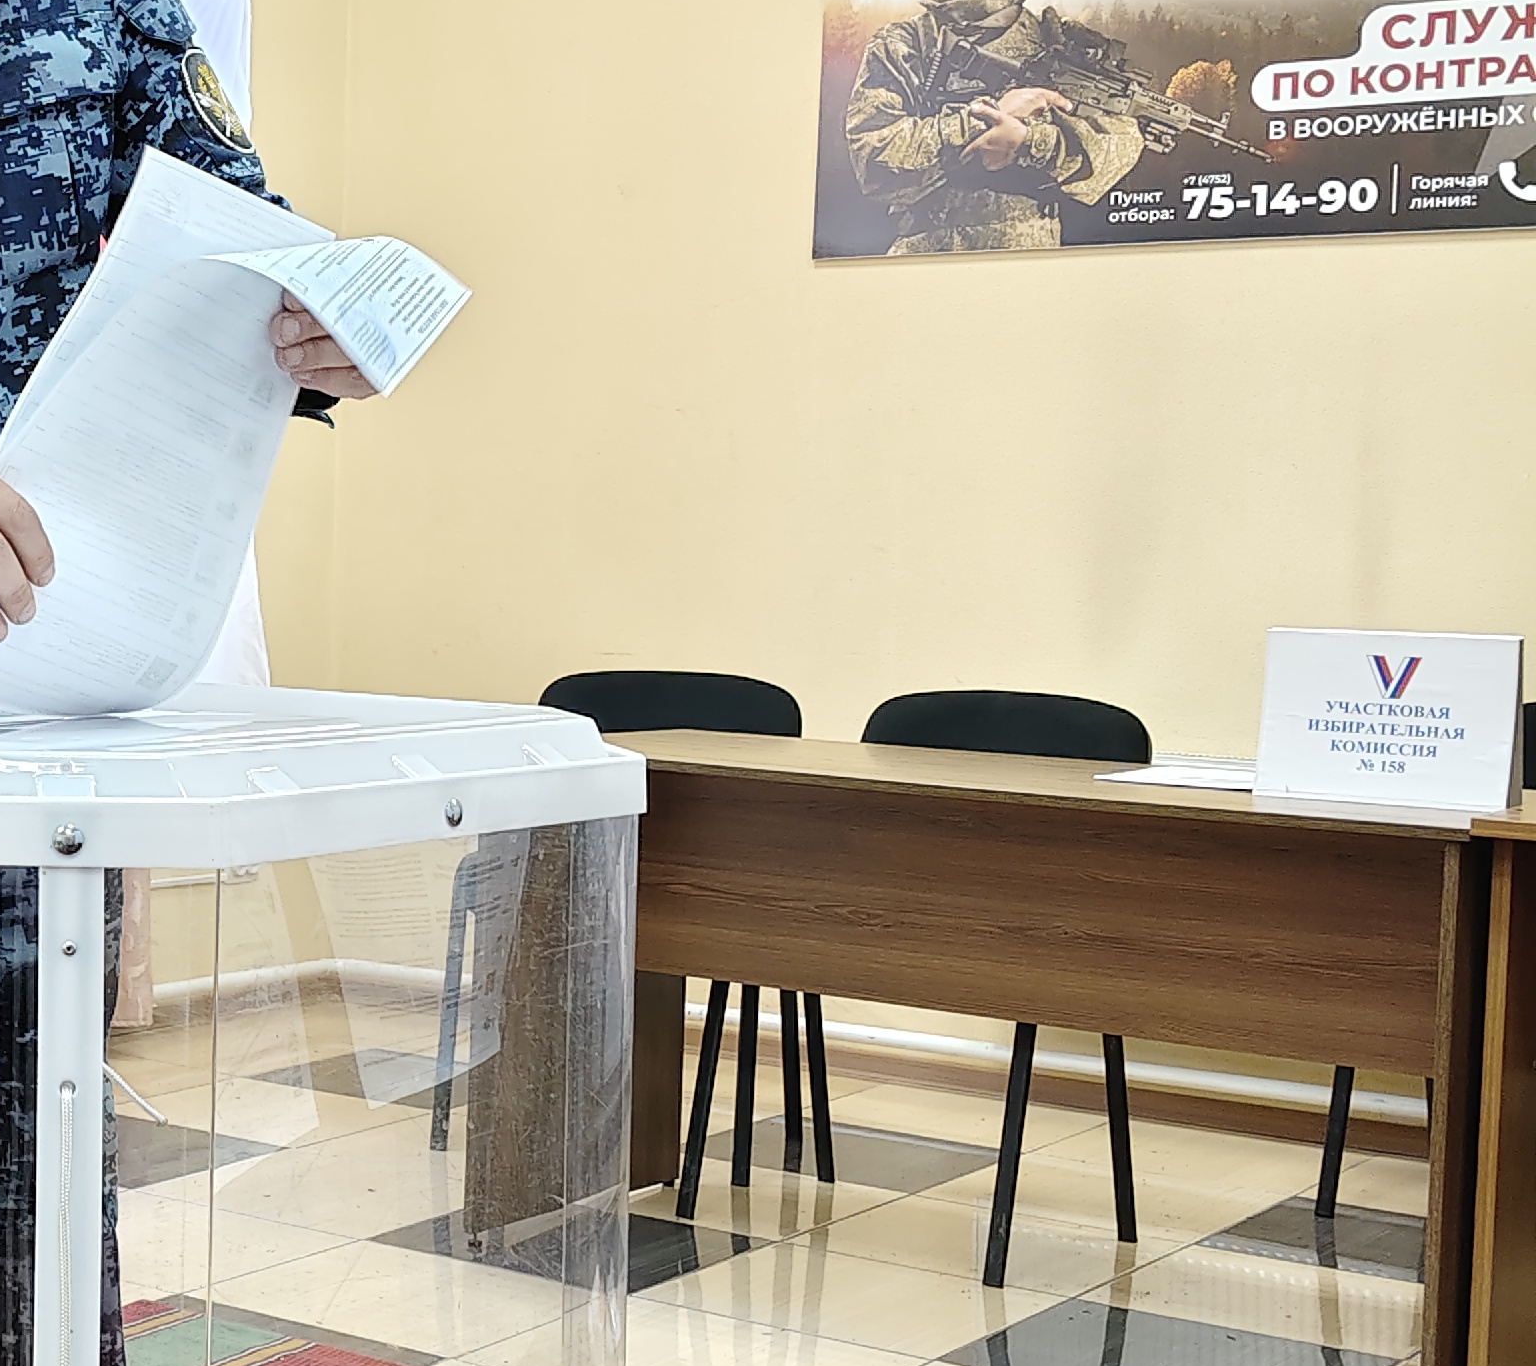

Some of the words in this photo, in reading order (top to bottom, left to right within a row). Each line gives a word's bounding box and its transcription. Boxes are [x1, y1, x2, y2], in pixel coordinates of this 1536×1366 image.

[1272, 69, 1334, 101] ПО
[1350, 54, 1536, 95] КОНТРА
[1269, 120, 1287, 140] В
[1293, 105, 1525, 139] ВООРУЖЁННЫХ
[1182, 176, 1196, 185] +7
[1197, 173, 1231, 186] (4752)
[1411, 175, 1489, 192] Горячая
[1109, 191, 1163, 207] Пункт
[1181, 178, 1379, 220] 75-14-90
[1408, 195, 1477, 210] линия:
[1108, 209, 1175, 224] отбора:
[1325, 700, 1451, 720] УЧАСТКОВАЯ
[1307, 718, 1465, 740] ИЗБИРАТЕЛЬНАЯ
[1330, 739, 1438, 758] КОМИССИЯ
[1356, 758, 1375, 772] №
[1380, 760, 1406, 774] 158
